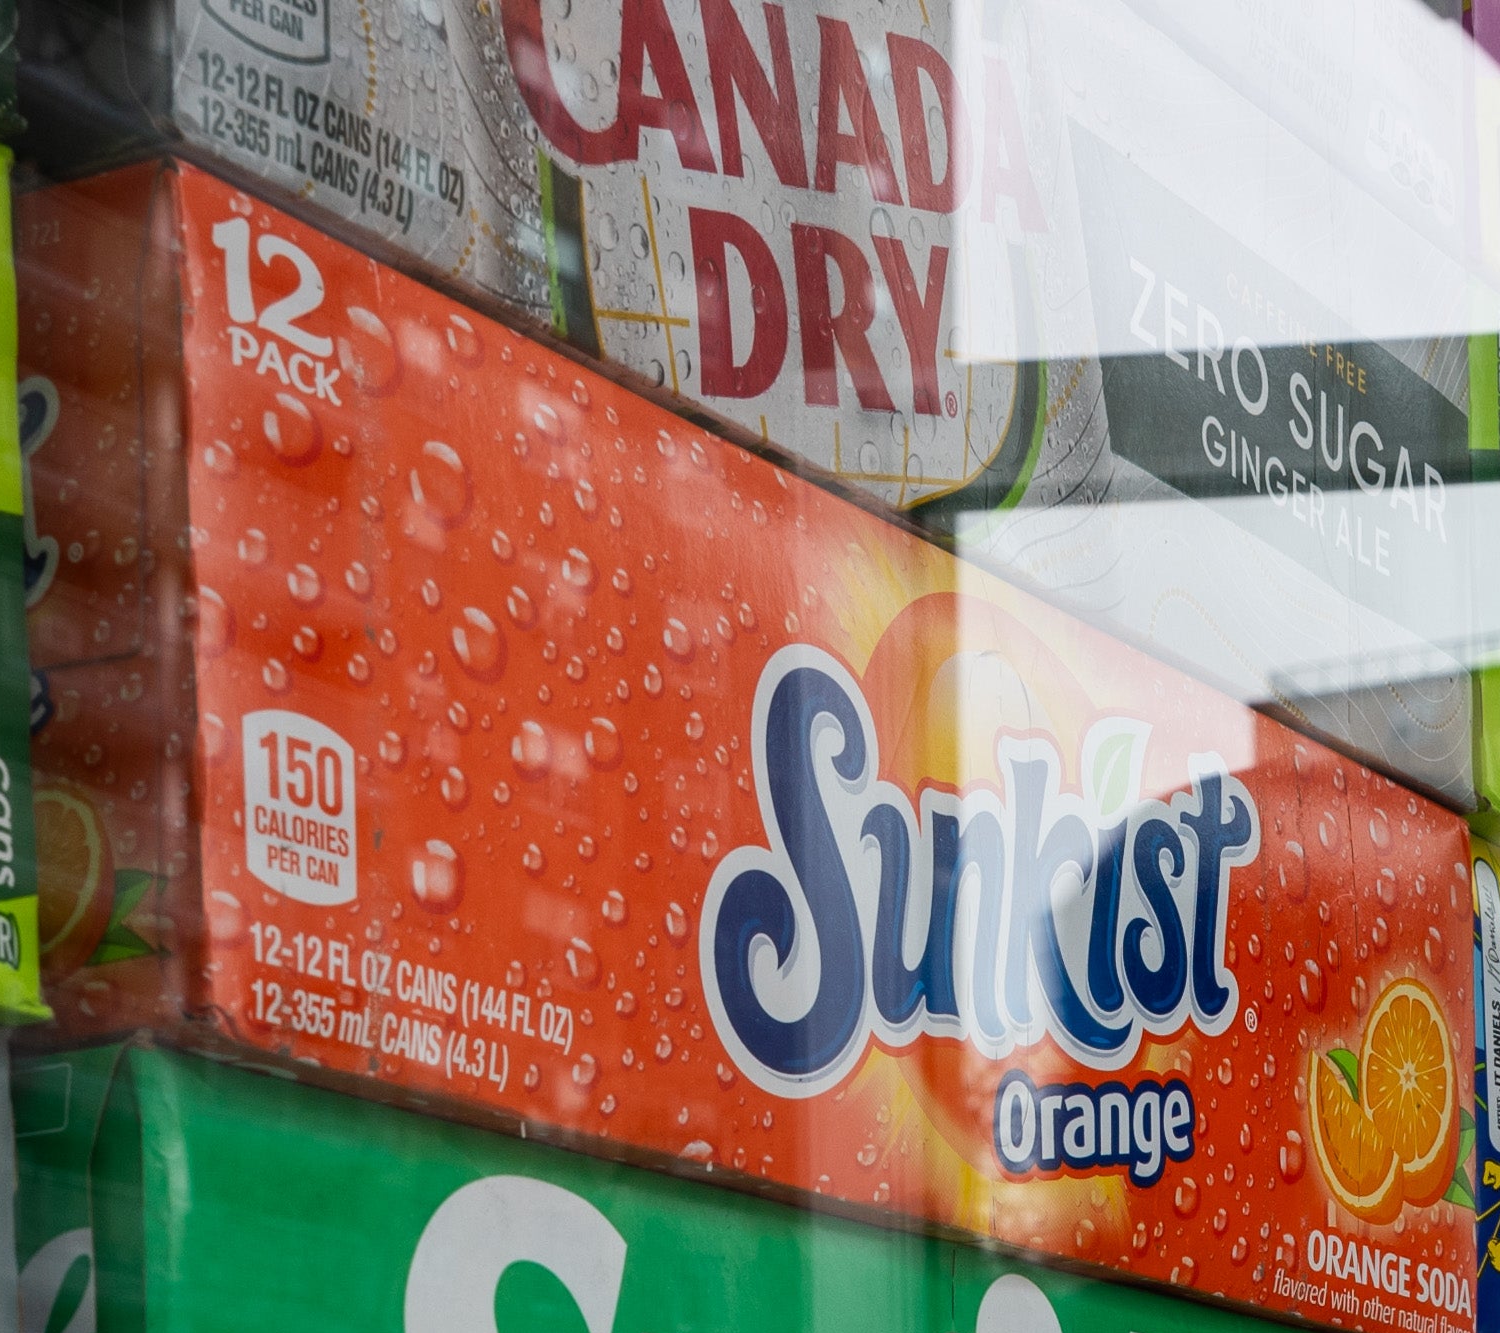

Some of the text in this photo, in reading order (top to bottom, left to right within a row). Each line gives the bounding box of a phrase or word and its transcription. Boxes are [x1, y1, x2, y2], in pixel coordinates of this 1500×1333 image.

[212, 218, 334, 359] 12
[689, 207, 949, 416] DRY
[229, 327, 341, 407] PACK
[1130, 257, 1446, 543] ZERO SUGAR
[1326, 344, 1368, 394] FREE
[1201, 416, 1324, 537] GINGER
[259, 731, 342, 817] 150
[255, 806, 350, 858] CALORIES
[267, 844, 338, 887] PER CAN
[708, 655, 1255, 1085] Sunkist
[250, 921, 574, 1055] 12-12 FL OZ CANS (144 FL OZ)
[252, 980, 509, 1092] 12-355 mL CANS (4.3 L)
[998, 1076, 1194, 1178] Orange
[1273, 1268, 1327, 1306] flavored
[1331, 1288, 1359, 1315] with
[1363, 1296, 1395, 1325] other
[1308, 1229, 1472, 1318] ORANGE SODA
